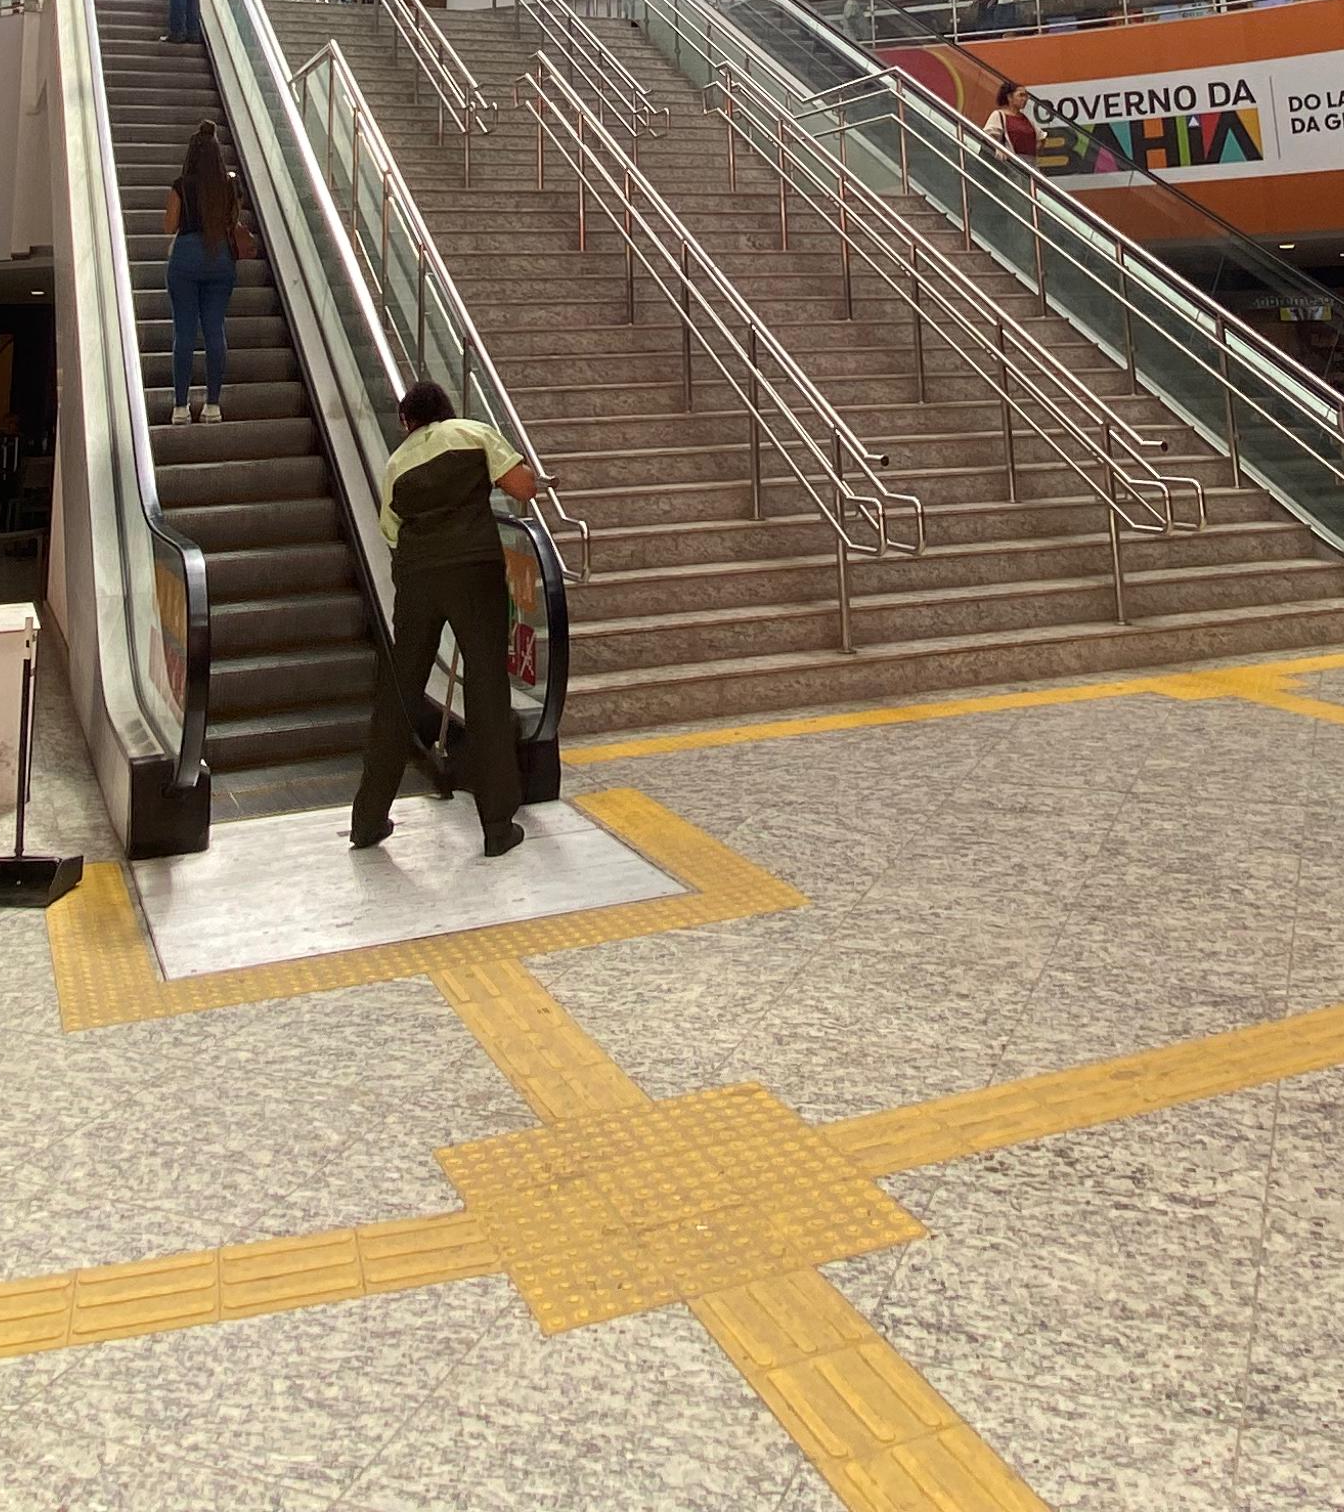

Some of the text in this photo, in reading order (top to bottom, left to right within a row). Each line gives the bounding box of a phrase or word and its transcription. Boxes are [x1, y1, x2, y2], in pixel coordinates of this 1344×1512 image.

[1033, 79, 1257, 125] GOVERNO DA
[1288, 93, 1321, 113] DO
[1290, 116, 1321, 134] DA
[1035, 107, 1265, 177] BAHIA
